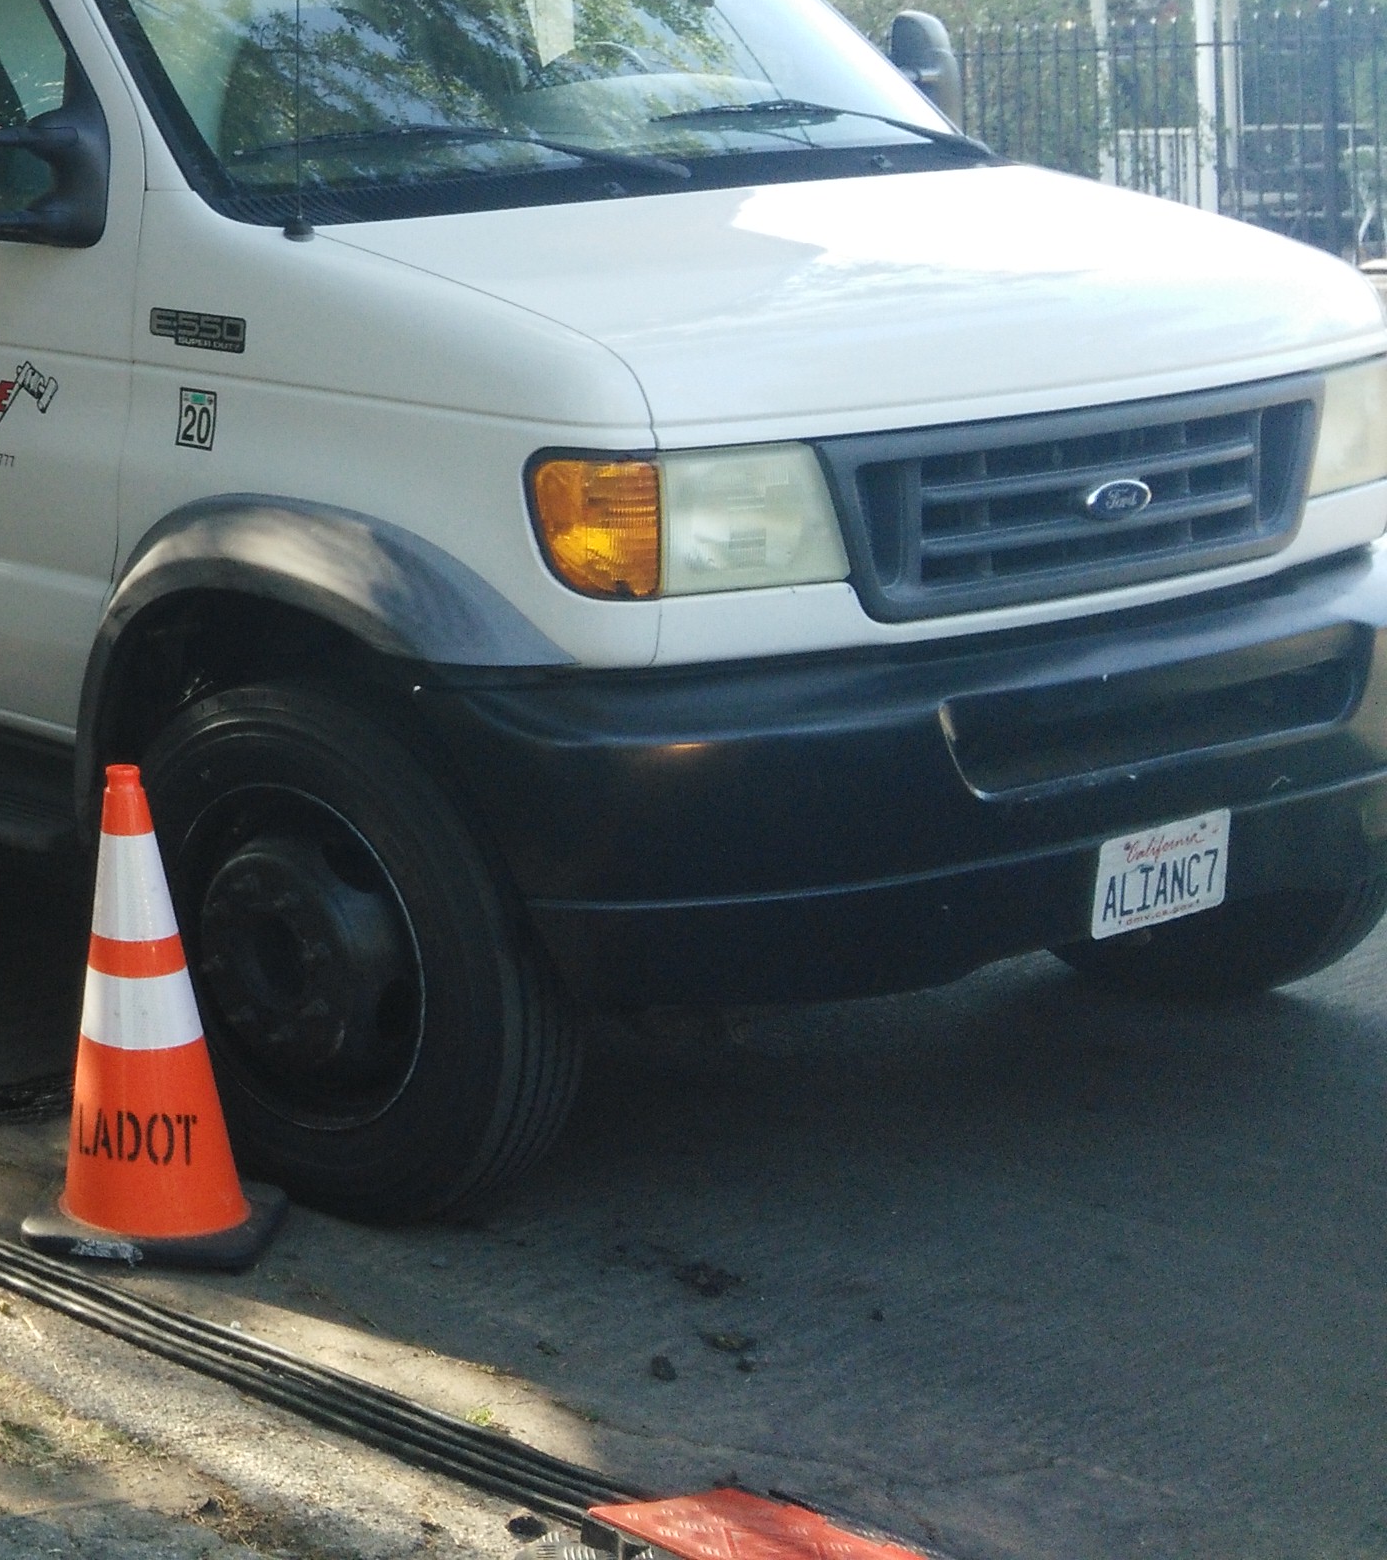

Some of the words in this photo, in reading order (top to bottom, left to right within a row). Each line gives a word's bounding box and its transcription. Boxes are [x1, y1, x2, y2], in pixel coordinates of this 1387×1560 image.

[151, 309, 244, 340] E550
[182, 404, 211, 444] 20
[1106, 488, 1138, 509] Ford
[1126, 833, 1205, 864] California
[1101, 847, 1219, 923] ALIANC7
[79, 1102, 197, 1166] LADOT
